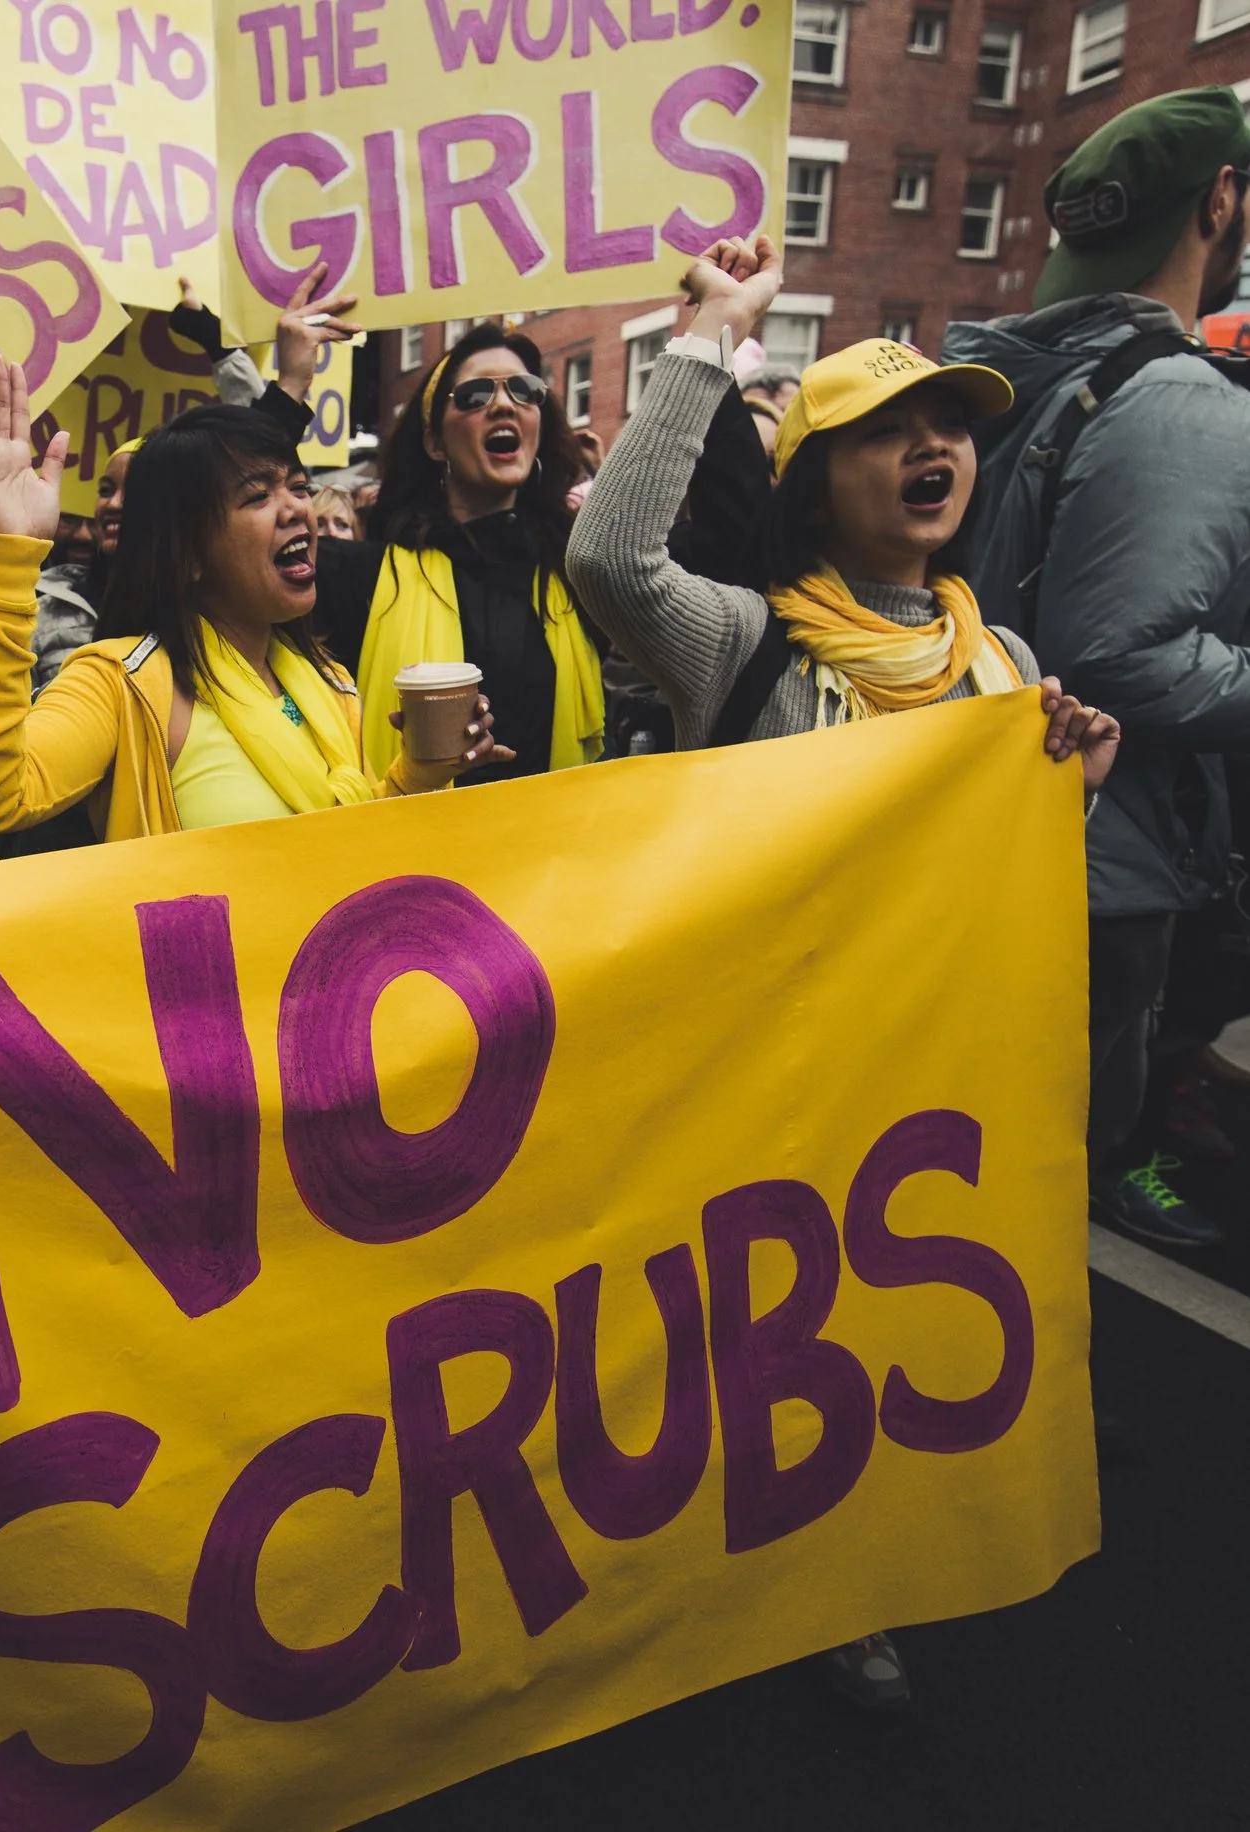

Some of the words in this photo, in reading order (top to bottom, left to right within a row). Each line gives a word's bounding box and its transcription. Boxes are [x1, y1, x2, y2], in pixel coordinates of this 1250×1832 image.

[9, 0, 92, 75] YO
[238, 0, 387, 106] THE
[21, 83, 126, 153] DE
[233, 64, 765, 308] GIRLS
